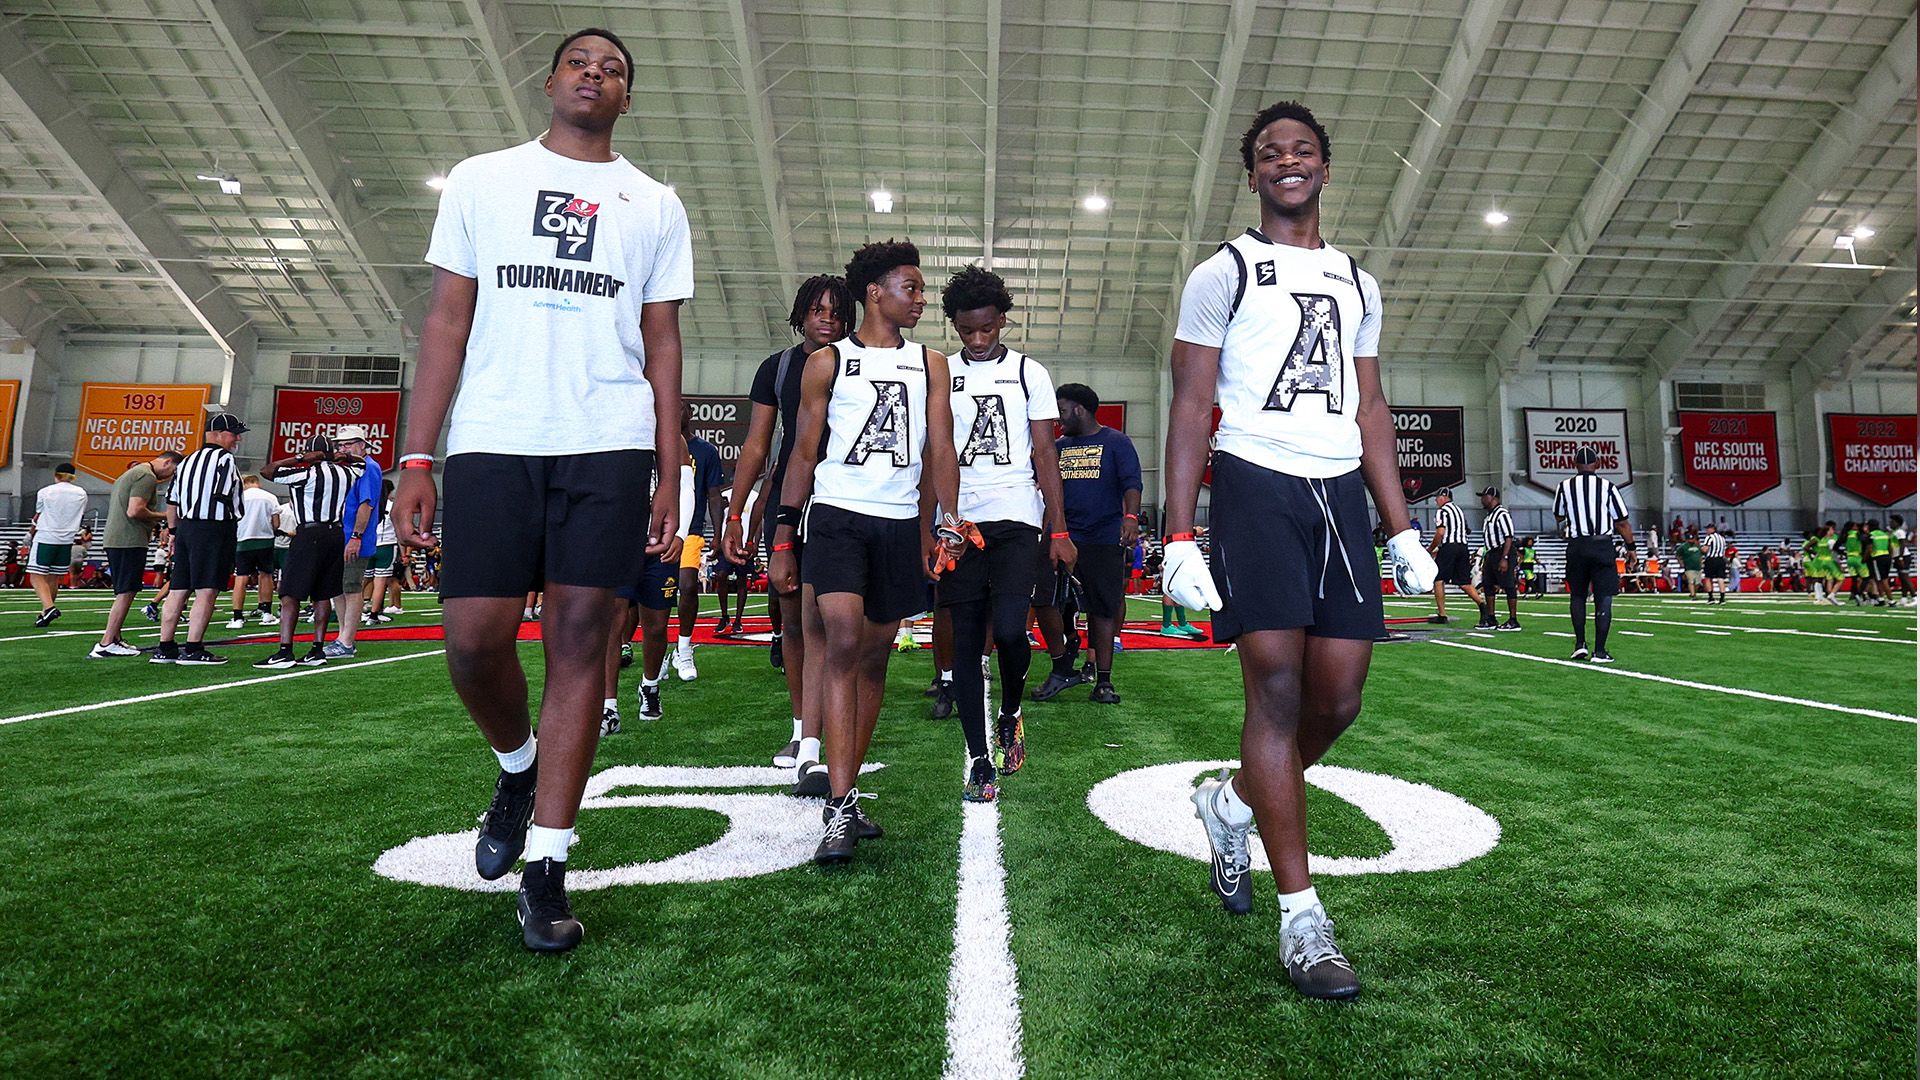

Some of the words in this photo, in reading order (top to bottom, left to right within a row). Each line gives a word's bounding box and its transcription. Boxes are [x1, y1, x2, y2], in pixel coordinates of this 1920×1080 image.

[544, 195, 569, 214] 7
[541, 212, 589, 236] ON
[565, 235, 587, 255] 7
[496, 264, 625, 298] TOURNAMENT
[1261, 292, 1343, 415] A
[123, 393, 165, 411] 1981
[314, 397, 363, 415] 1999
[85, 418, 117, 434] NFC
[121, 419, 194, 435] CENTRAL
[280, 422, 311, 438] NFC
[315, 423, 389, 439] CERAL
[844, 380, 909, 468] A
[959, 394, 1012, 466] A
[1554, 417, 1597, 432] 2020
[1709, 418, 1748, 434] 2021
[1857, 421, 1897, 437] 2022
[90, 435, 187, 452] CHAMPIONS
[1397, 438, 1424, 453] NFC
[1535, 440, 1578, 455] SUPER
[1694, 441, 1719, 456] NFC
[1722, 442, 1764, 456] SOUTH
[1845, 444, 1870, 458] NFC
[1872, 445, 1914, 458] SOUTH
[1398, 453, 1452, 468] MPIONS
[1693, 456, 1768, 471] CHAMPIONS
[1844, 459, 1917, 473] CHAMPIONS
